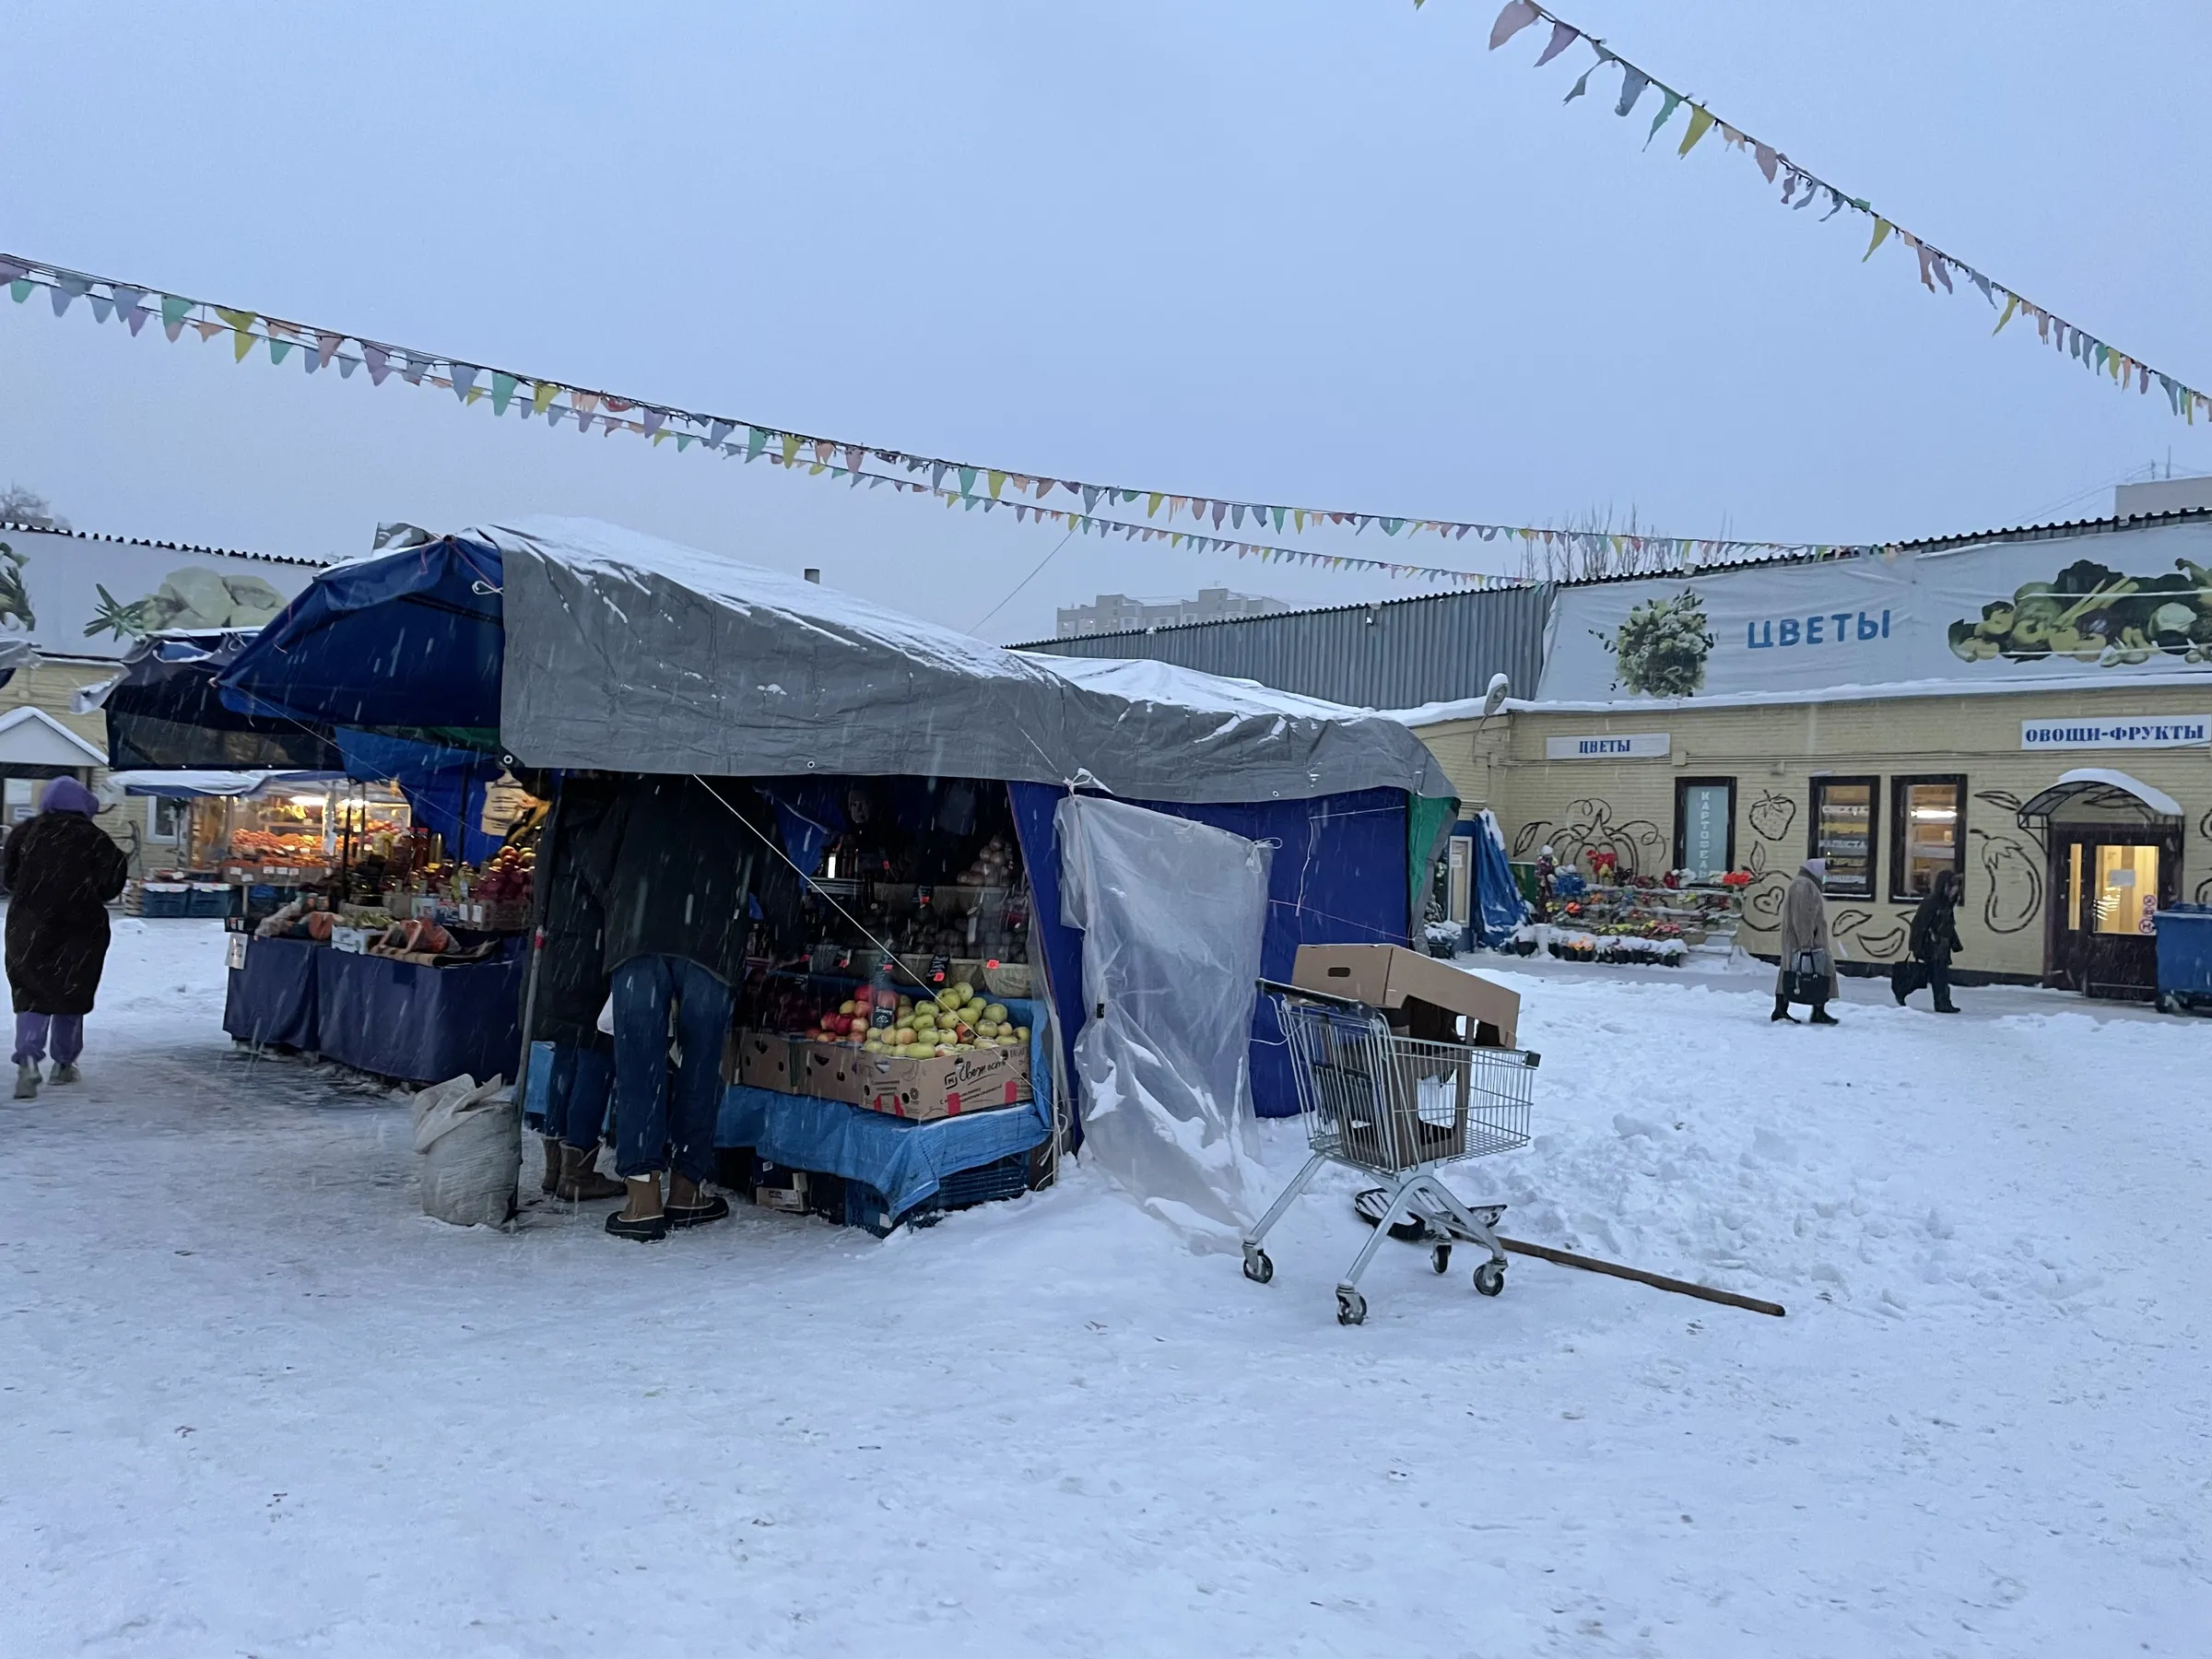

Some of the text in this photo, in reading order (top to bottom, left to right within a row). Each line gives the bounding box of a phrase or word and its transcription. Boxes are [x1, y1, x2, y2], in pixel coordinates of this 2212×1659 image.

[1747, 609, 1890, 649] ЦВЕТЫ
[1579, 739, 1630, 754] ЦВЕТЫ
[2026, 724, 2204, 743] ОВОЩИ-ФРУКТЫ
[1699, 791, 1711, 878] КАРТОФЕЛЬ
